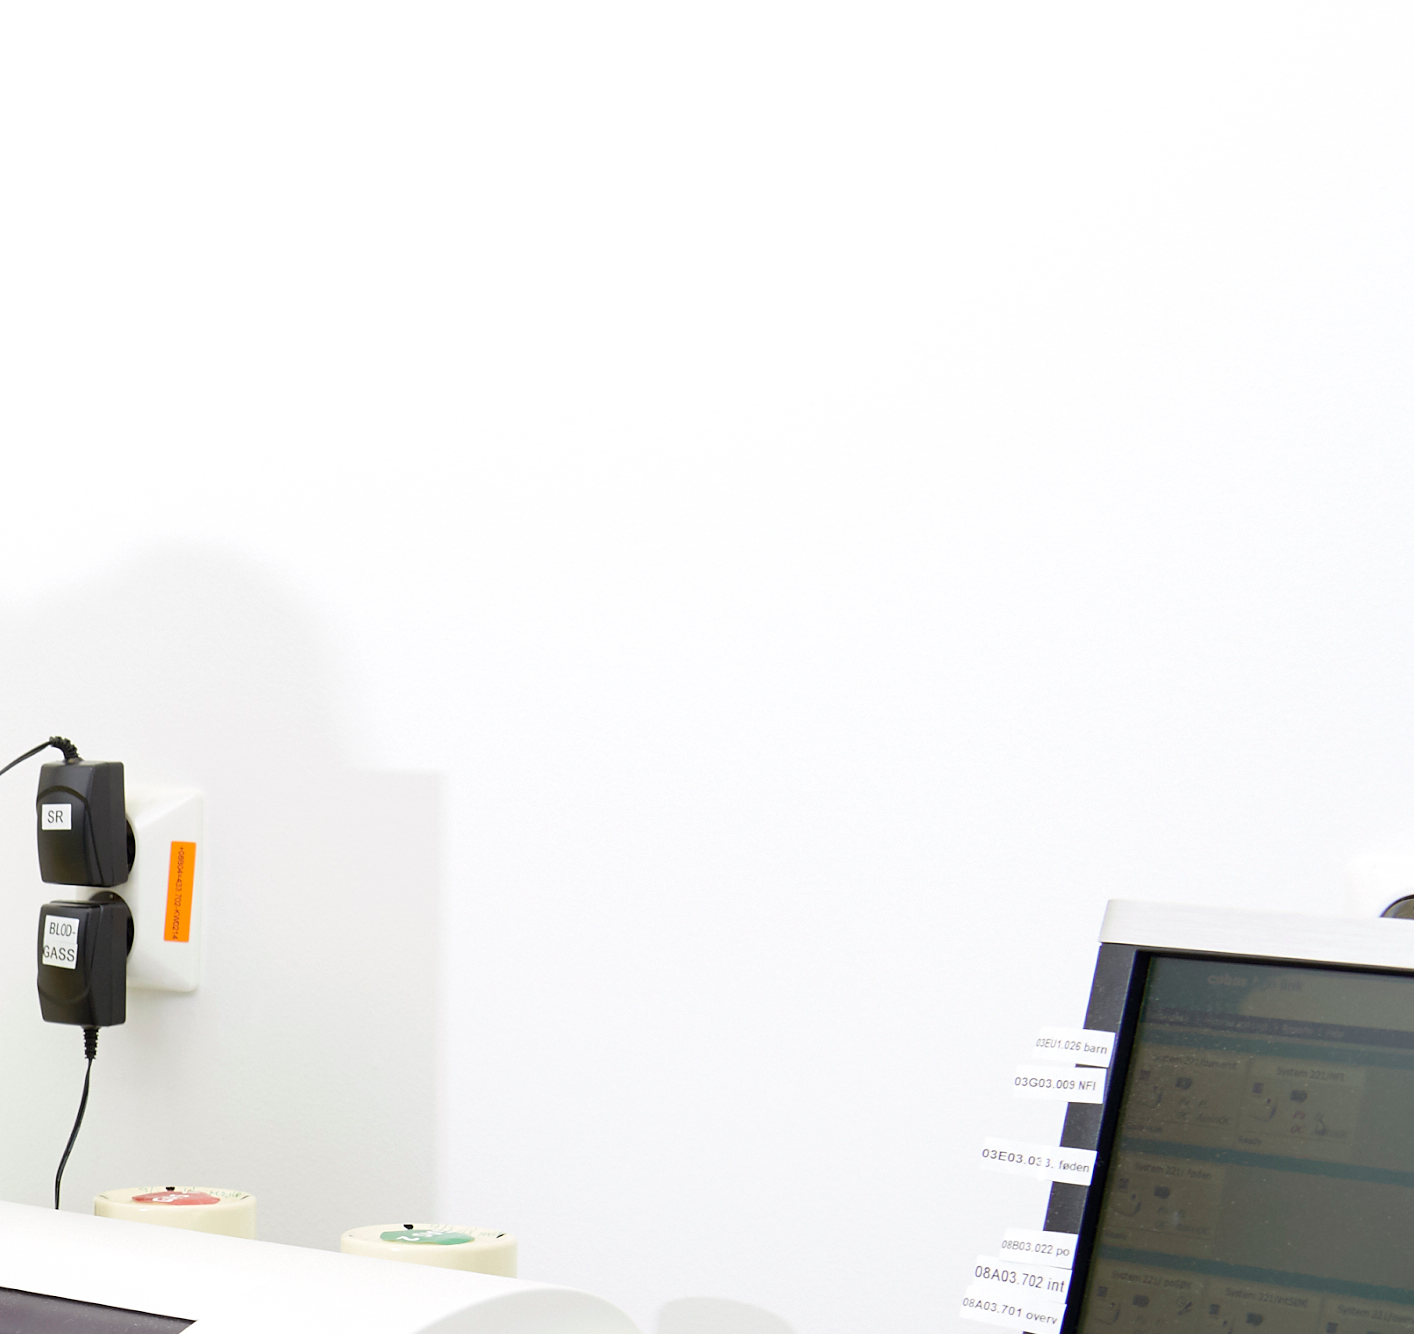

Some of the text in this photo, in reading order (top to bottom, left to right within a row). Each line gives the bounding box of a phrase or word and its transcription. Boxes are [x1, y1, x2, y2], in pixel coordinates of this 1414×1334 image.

[47, 810, 64, 824] SR
[49, 921, 77, 937] BLOD-
[43, 944, 75, 962] GASS
[1035, 1038, 1108, 1054] 03EU1.026 barn
[1014, 1076, 1096, 1091] 03G03.009 NFI
[1059, 1160, 1090, 1173] føden
[1001, 1239, 1070, 1257] 08B03.022 po
[975, 1265, 1065, 1292] 08A03.702 int
[962, 1297, 1058, 1324] 08A03.701 overv
